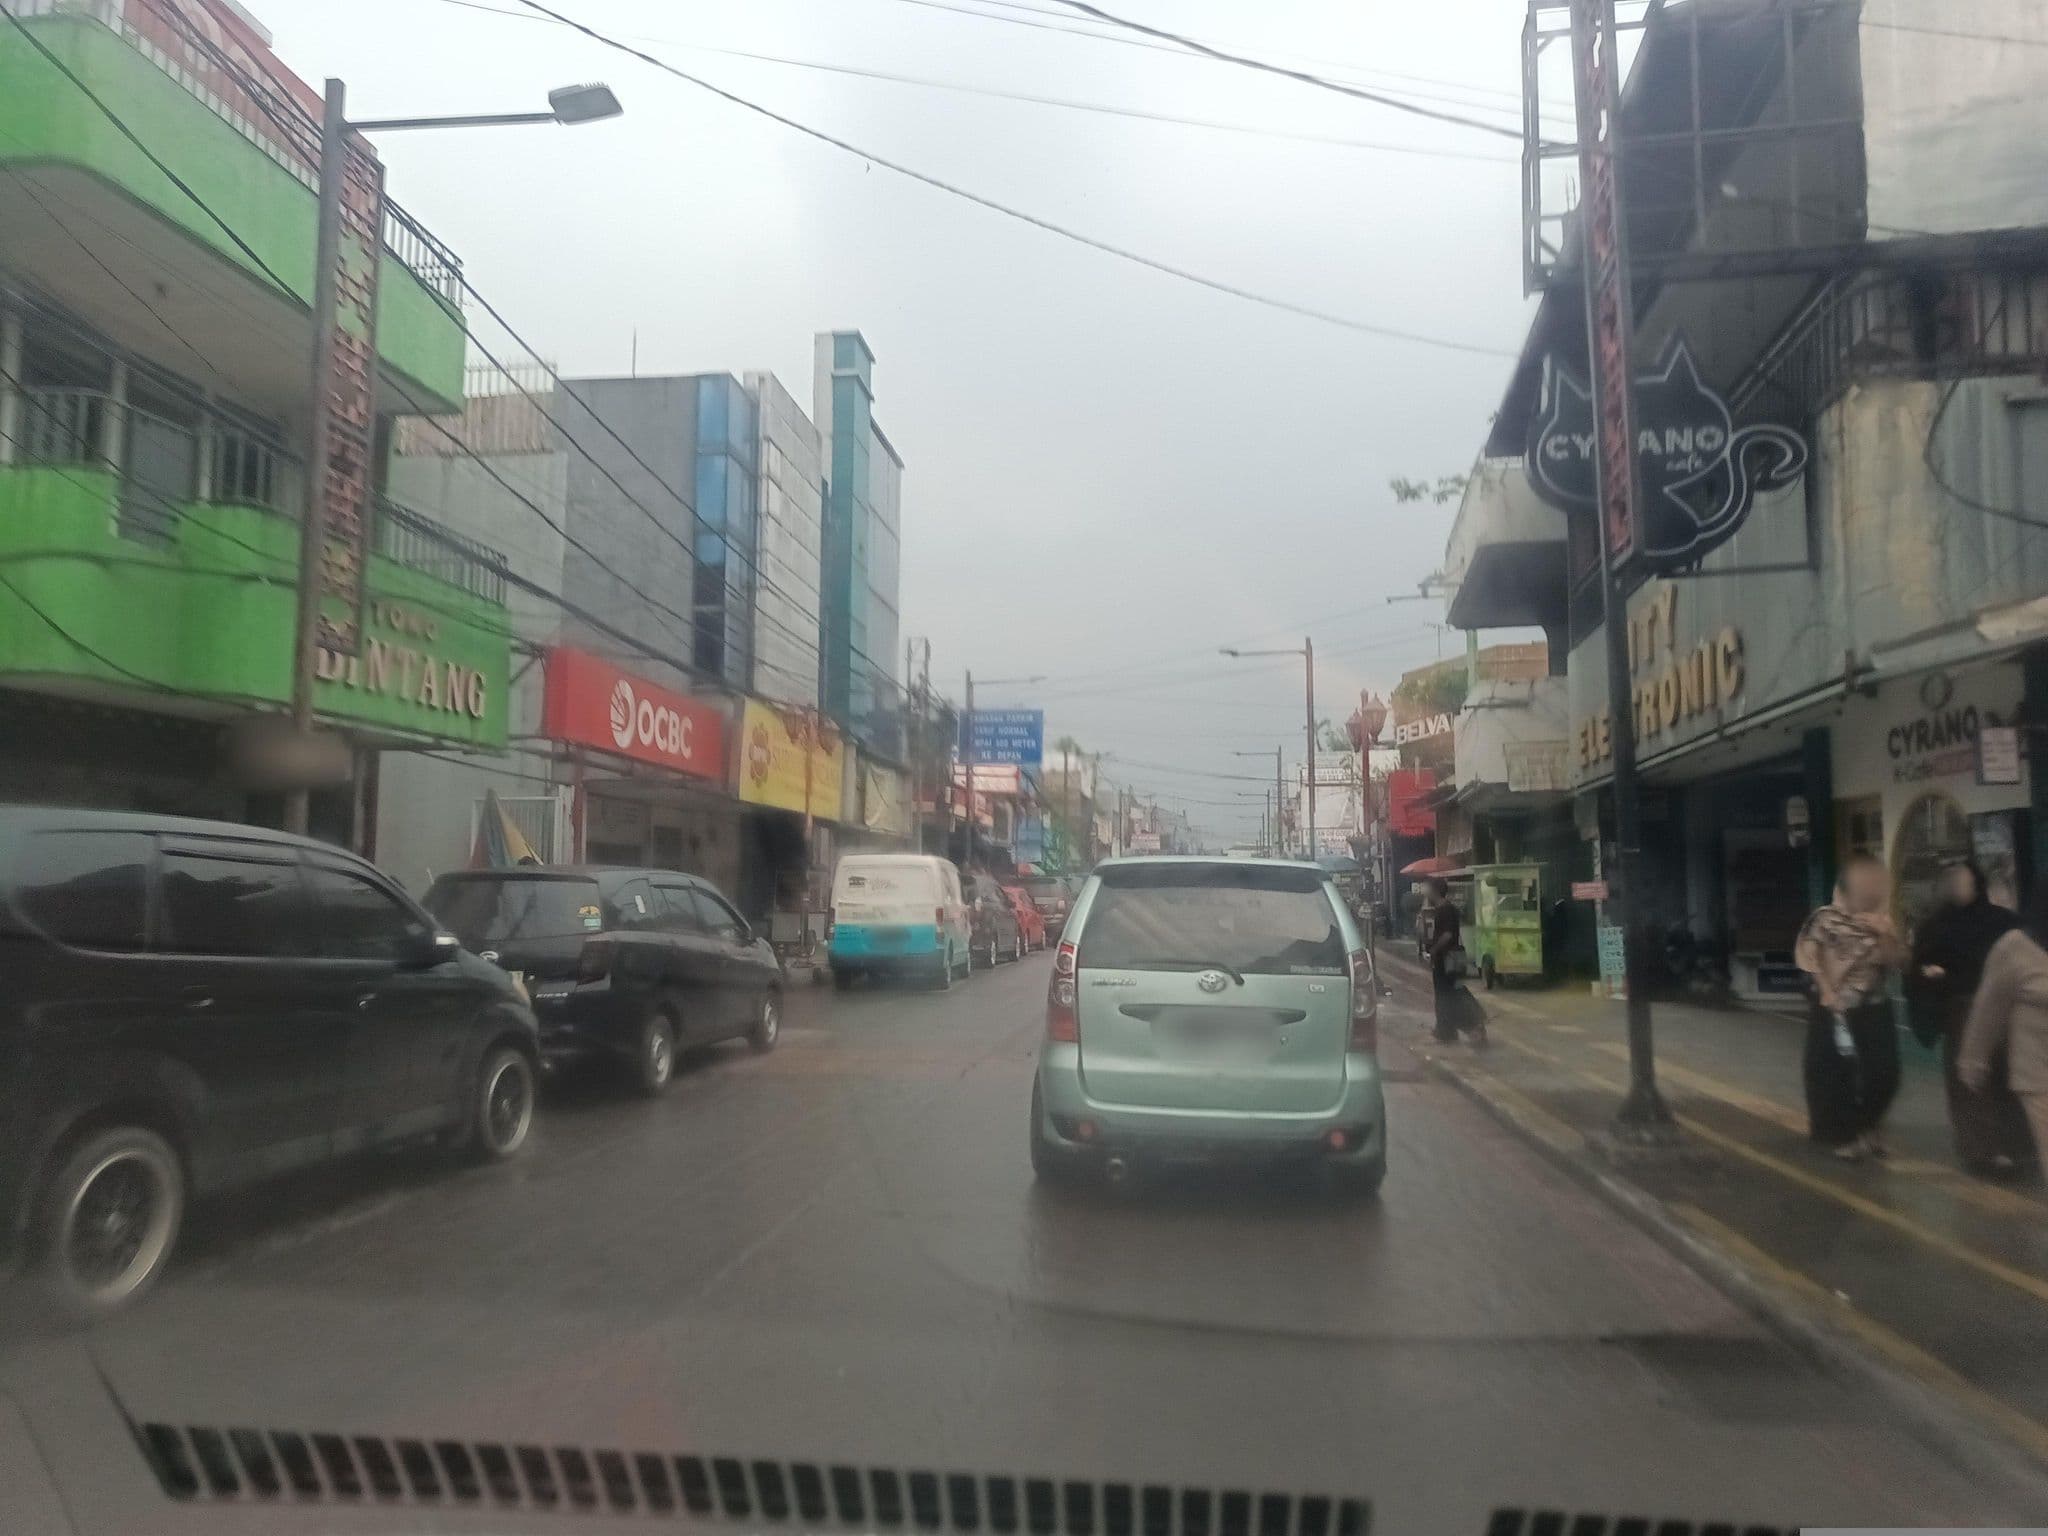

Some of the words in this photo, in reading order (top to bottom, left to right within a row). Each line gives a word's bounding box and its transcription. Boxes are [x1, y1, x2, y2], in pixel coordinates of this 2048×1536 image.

[1546, 425, 1726, 461] CYANO
[637, 700, 694, 760] OCBC
[1396, 712, 1454, 745] BELVA
[1887, 704, 1979, 760] CYRANO
